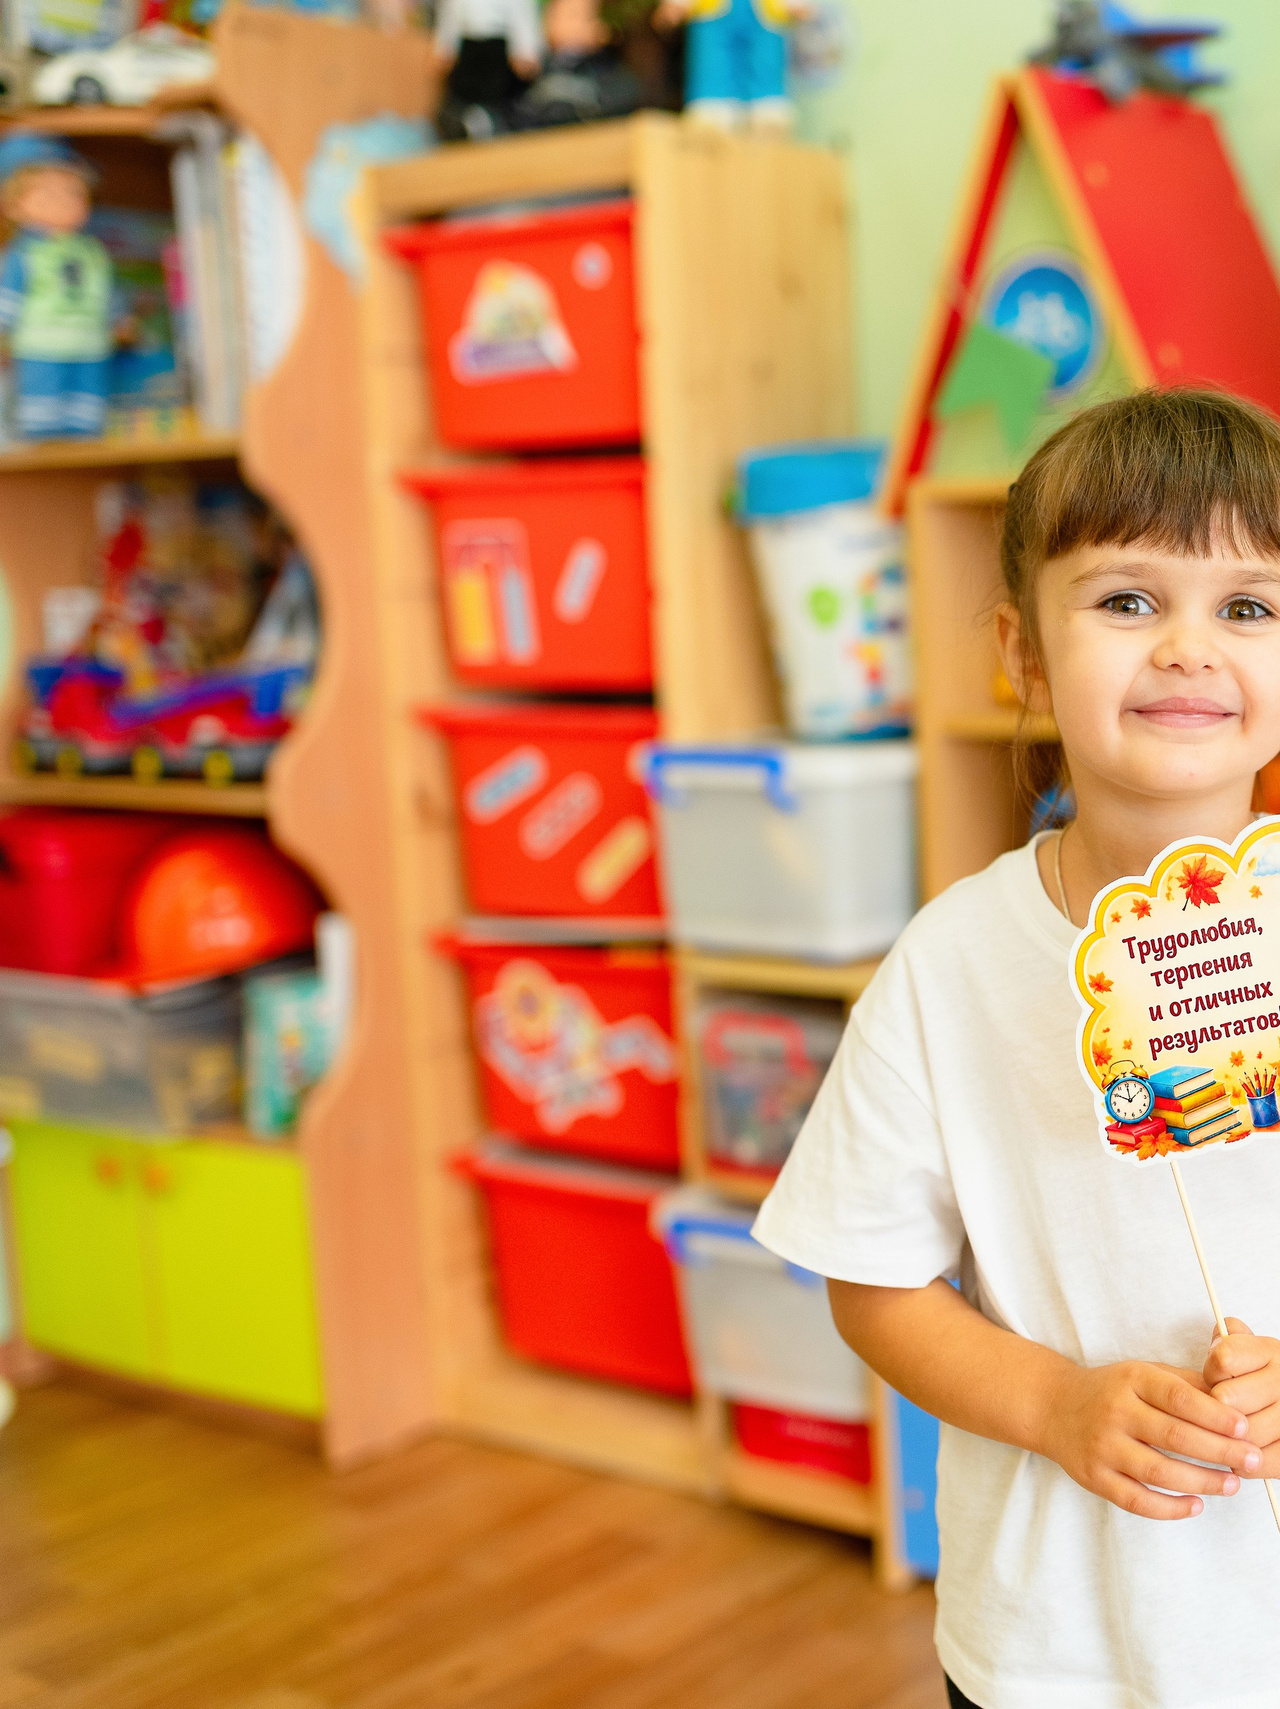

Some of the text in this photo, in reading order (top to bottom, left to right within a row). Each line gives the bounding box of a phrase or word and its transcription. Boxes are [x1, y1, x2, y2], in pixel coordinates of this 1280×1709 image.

[1121, 917, 1263, 964] Трудолюбия,
[1150, 952, 1253, 990] терпения
[1149, 981, 1274, 1021] и отличных
